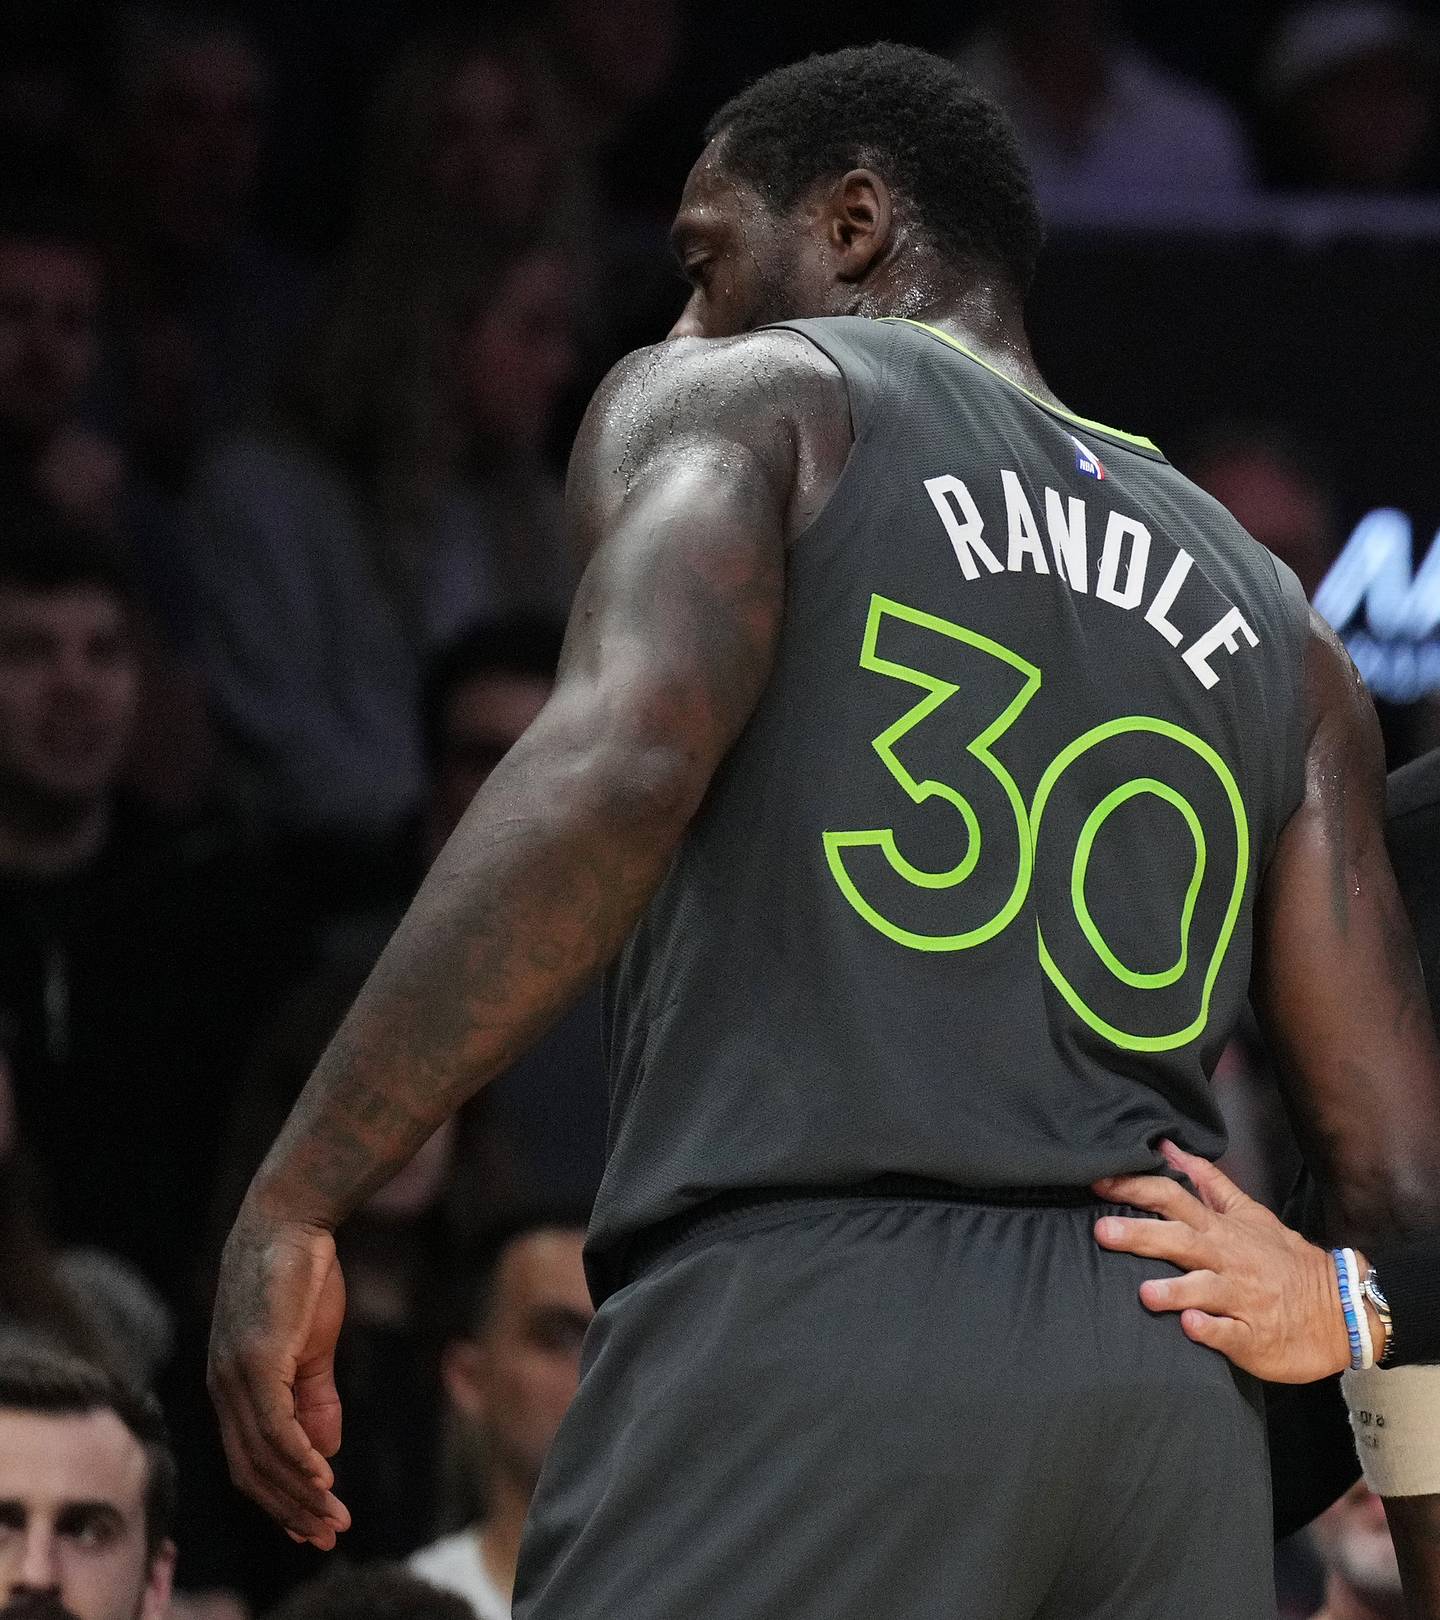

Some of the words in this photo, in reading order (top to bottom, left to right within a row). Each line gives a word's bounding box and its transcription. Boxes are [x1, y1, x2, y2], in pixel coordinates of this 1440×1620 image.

[1079, 458, 1095, 475] NBA
[924, 470, 1259, 689] RANDLE
[823, 594, 1249, 1052] 30
